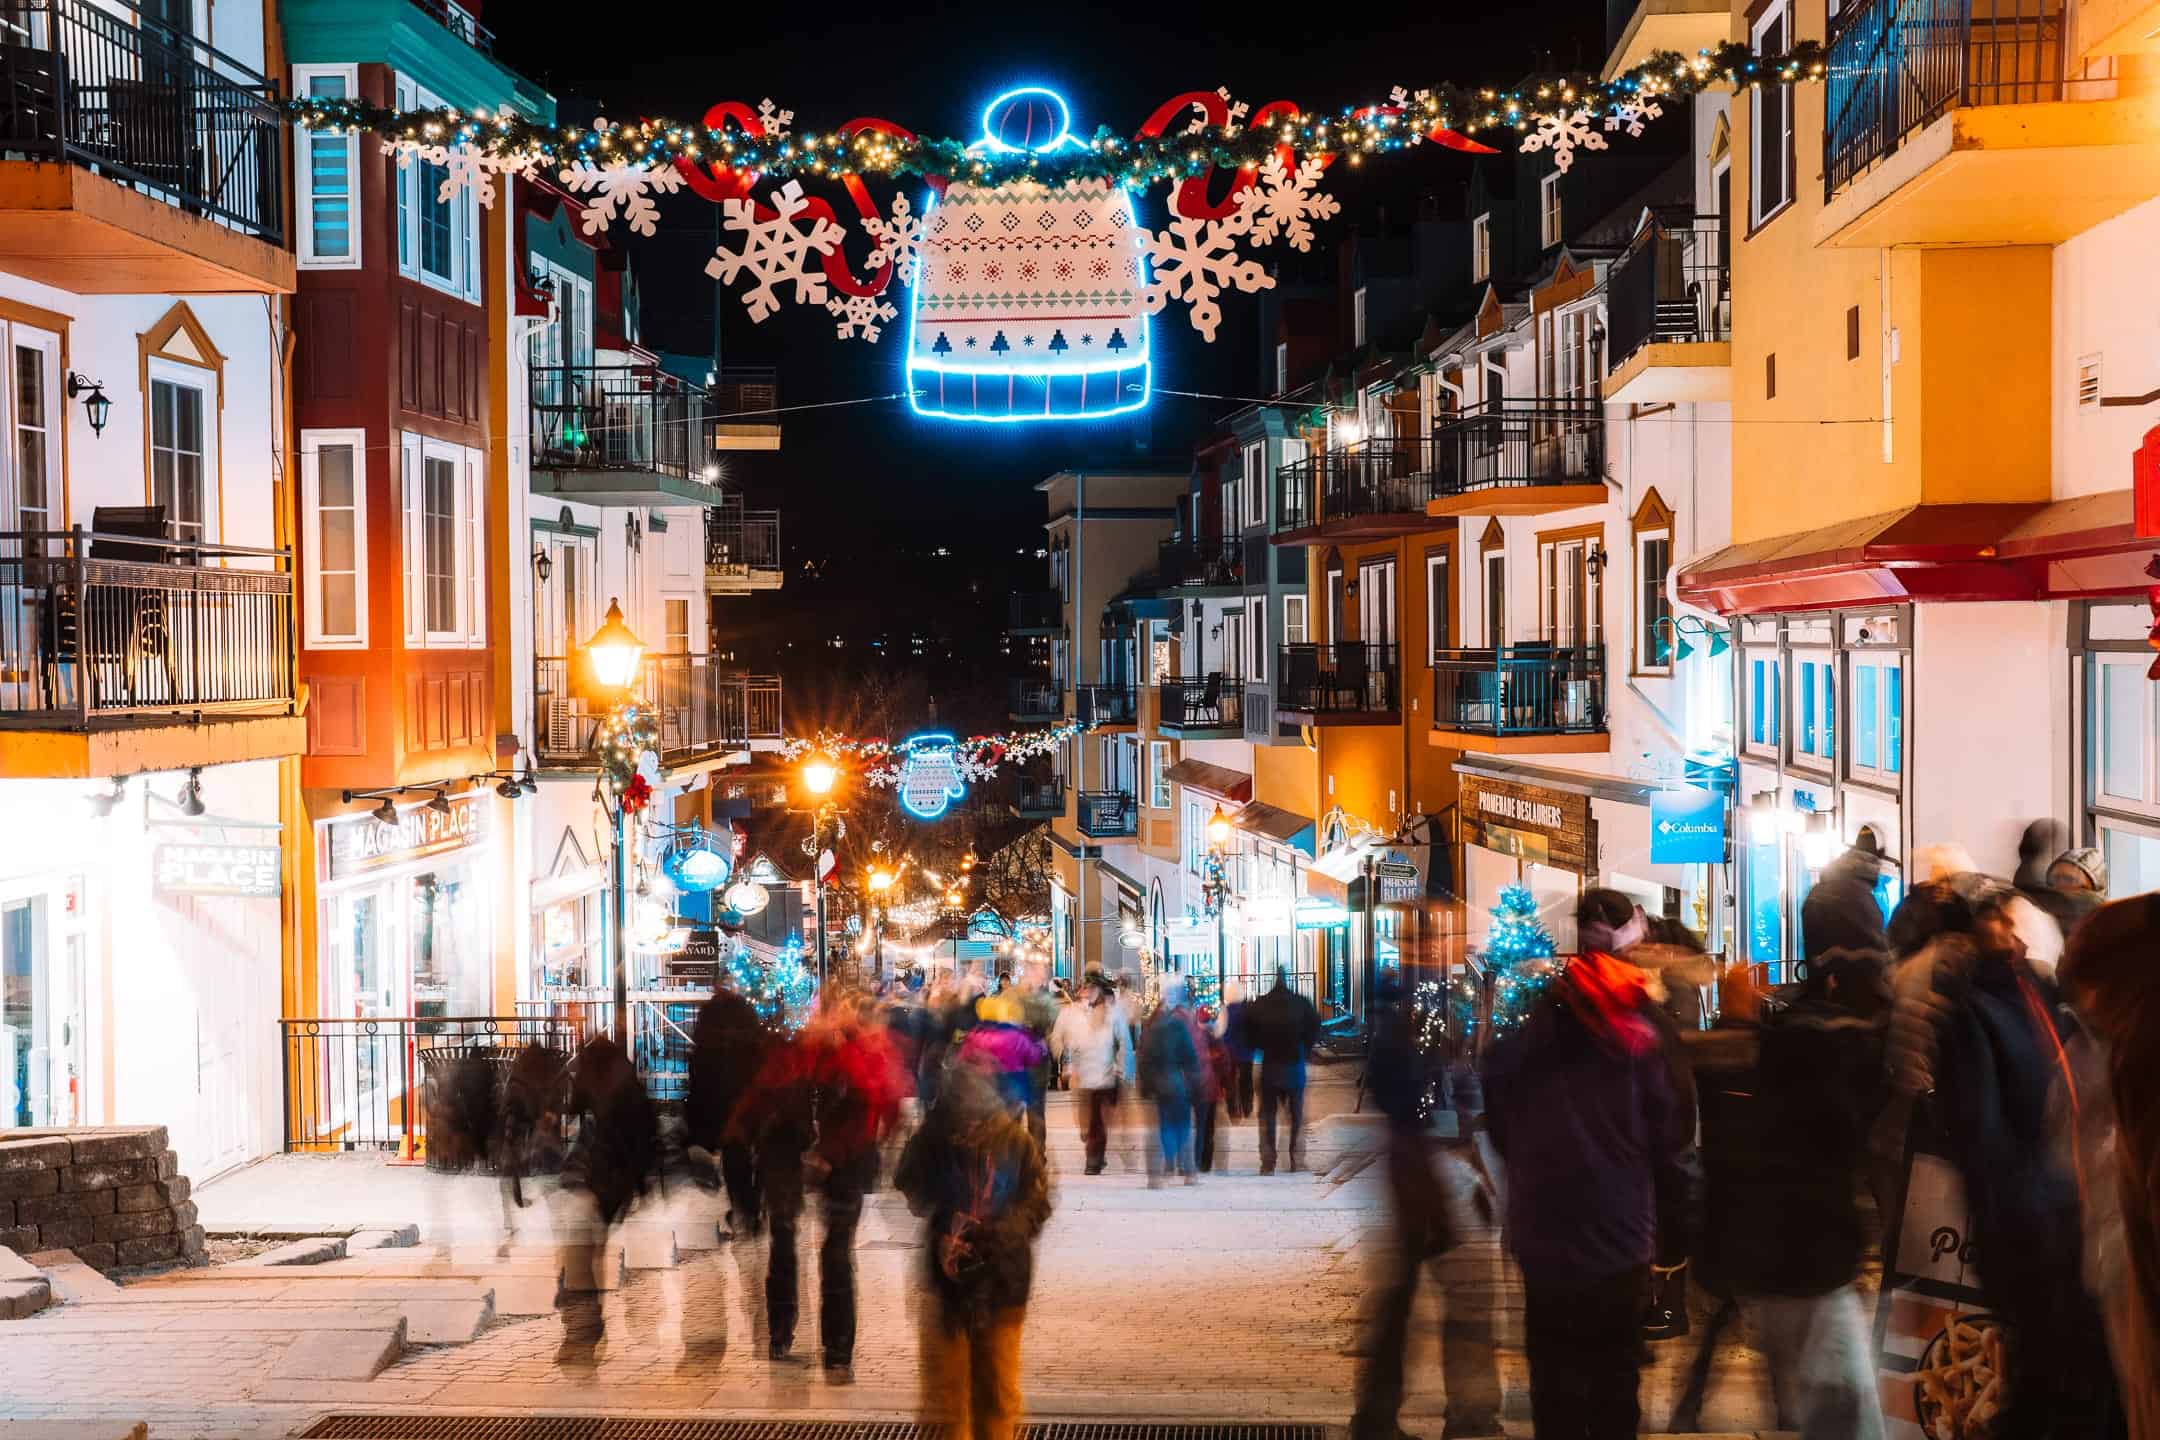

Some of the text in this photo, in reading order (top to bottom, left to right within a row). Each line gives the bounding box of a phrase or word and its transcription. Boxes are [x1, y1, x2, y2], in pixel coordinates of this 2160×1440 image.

[1479, 791, 1561, 829] PROMENADE DESLAURIERS
[351, 803, 477, 857] MAGASIN PLACE
[1671, 821, 1718, 833] Columbia
[160, 863, 275, 887] PLACE
